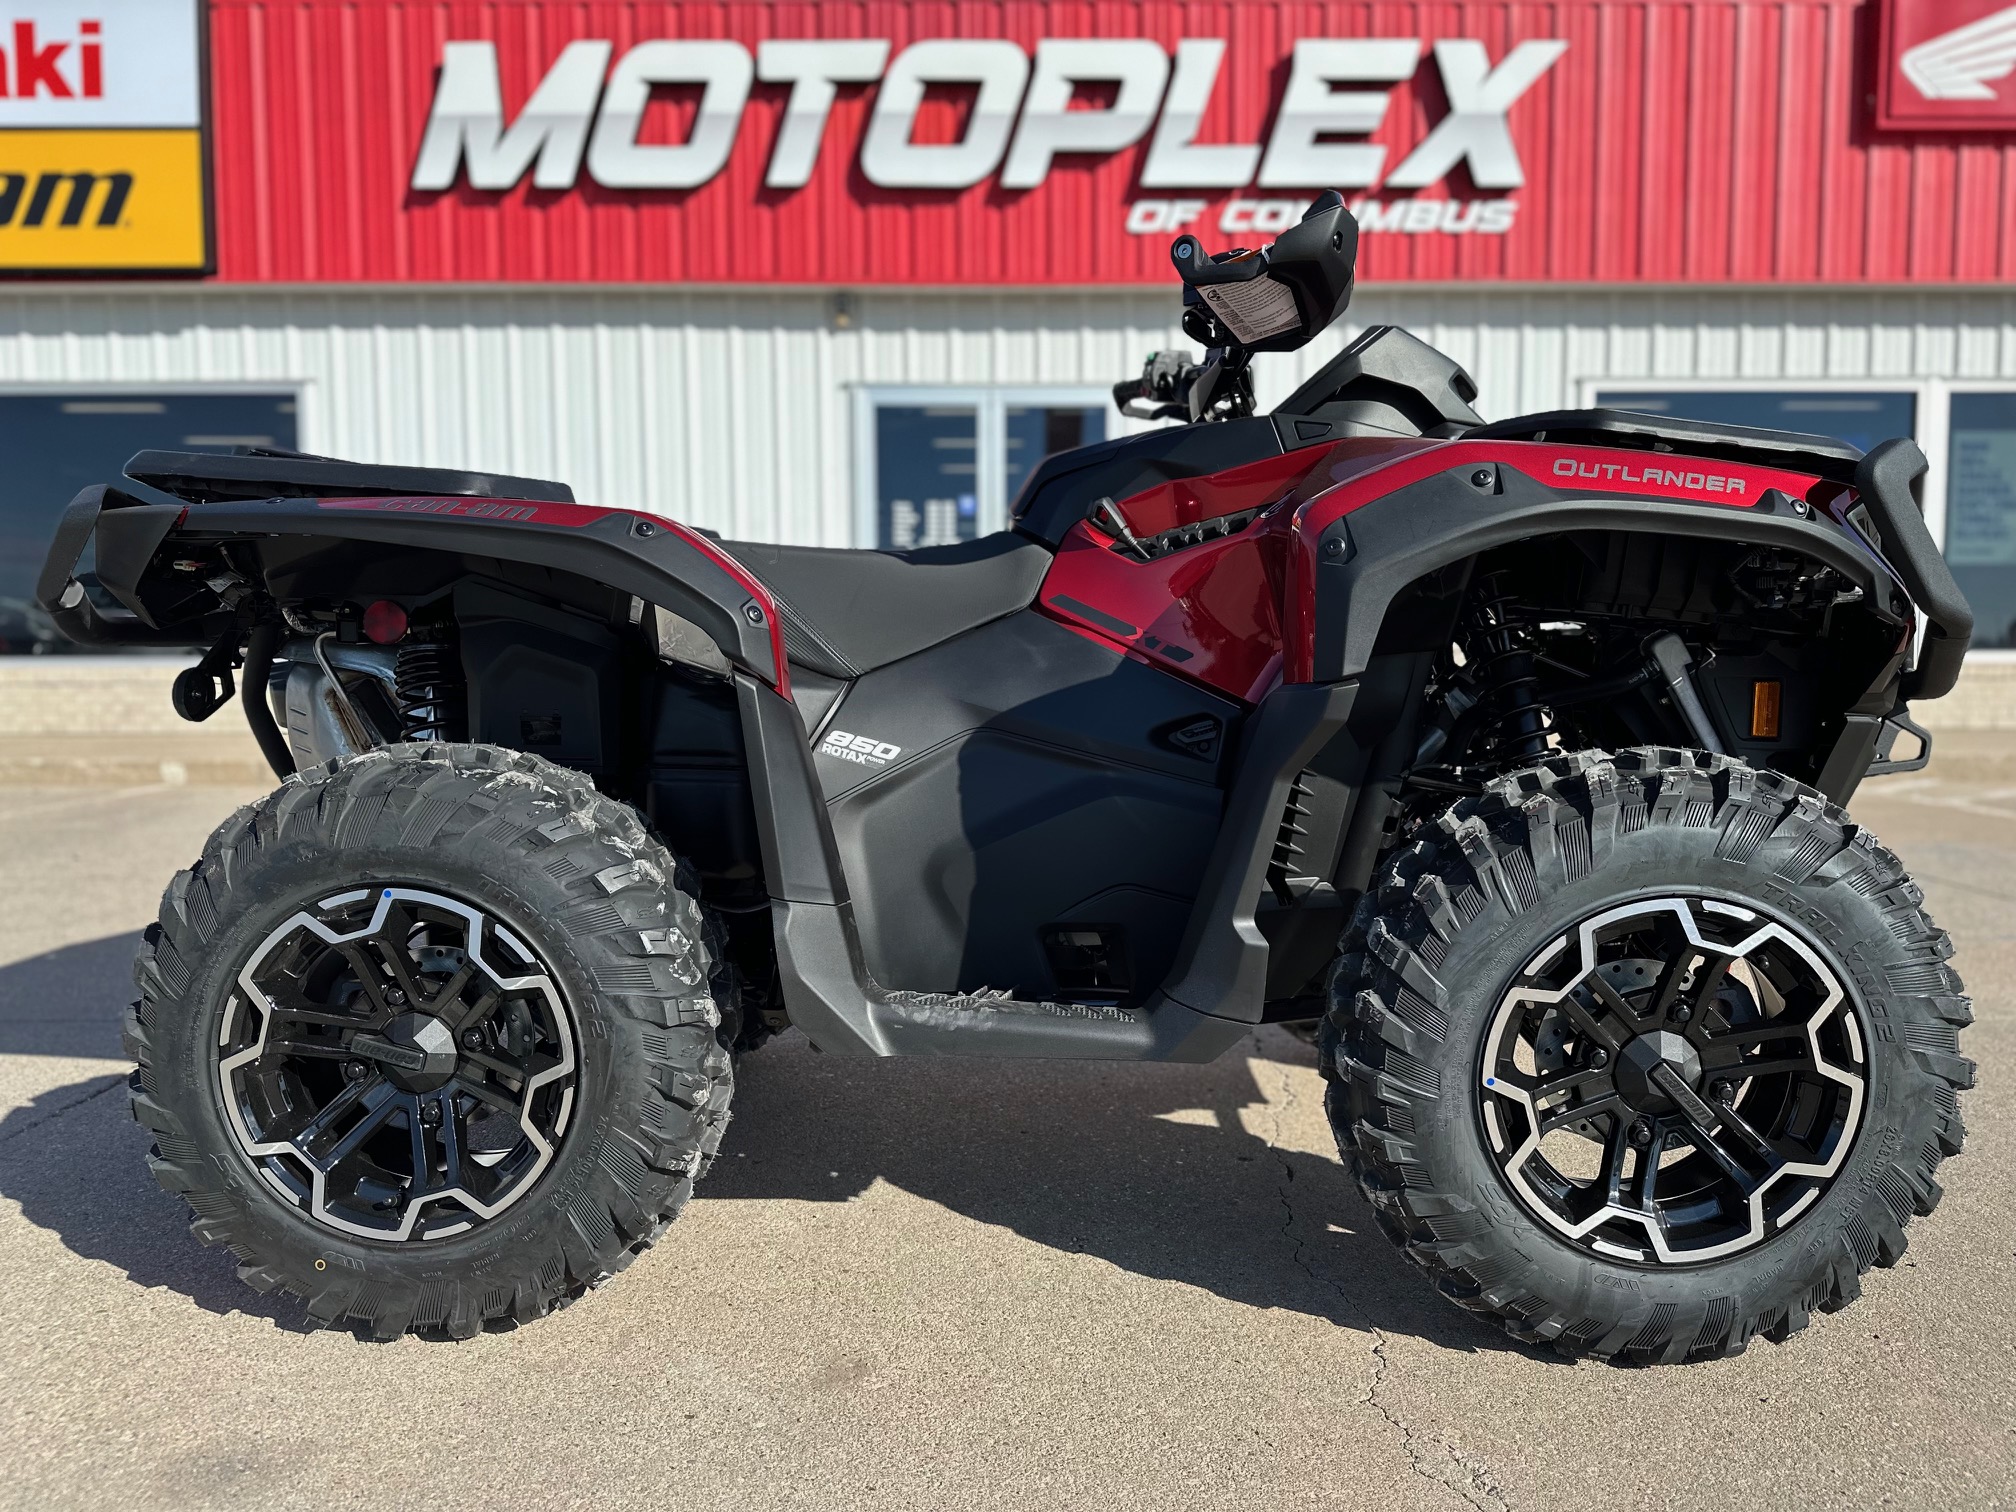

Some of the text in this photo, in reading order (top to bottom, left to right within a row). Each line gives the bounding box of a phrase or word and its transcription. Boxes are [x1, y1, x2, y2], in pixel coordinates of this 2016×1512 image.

[0, 20, 103, 98] ki
[410, 38, 1569, 191] MOTOPLEX
[1126, 199, 1519, 234] OF COMBUS
[1553, 459, 1746, 495] OUTLANDER
[821, 742, 886, 765] ROTAX POWER
[825, 730, 901, 760] 850
[1758, 880, 1896, 1045] TRAIL KING 2
